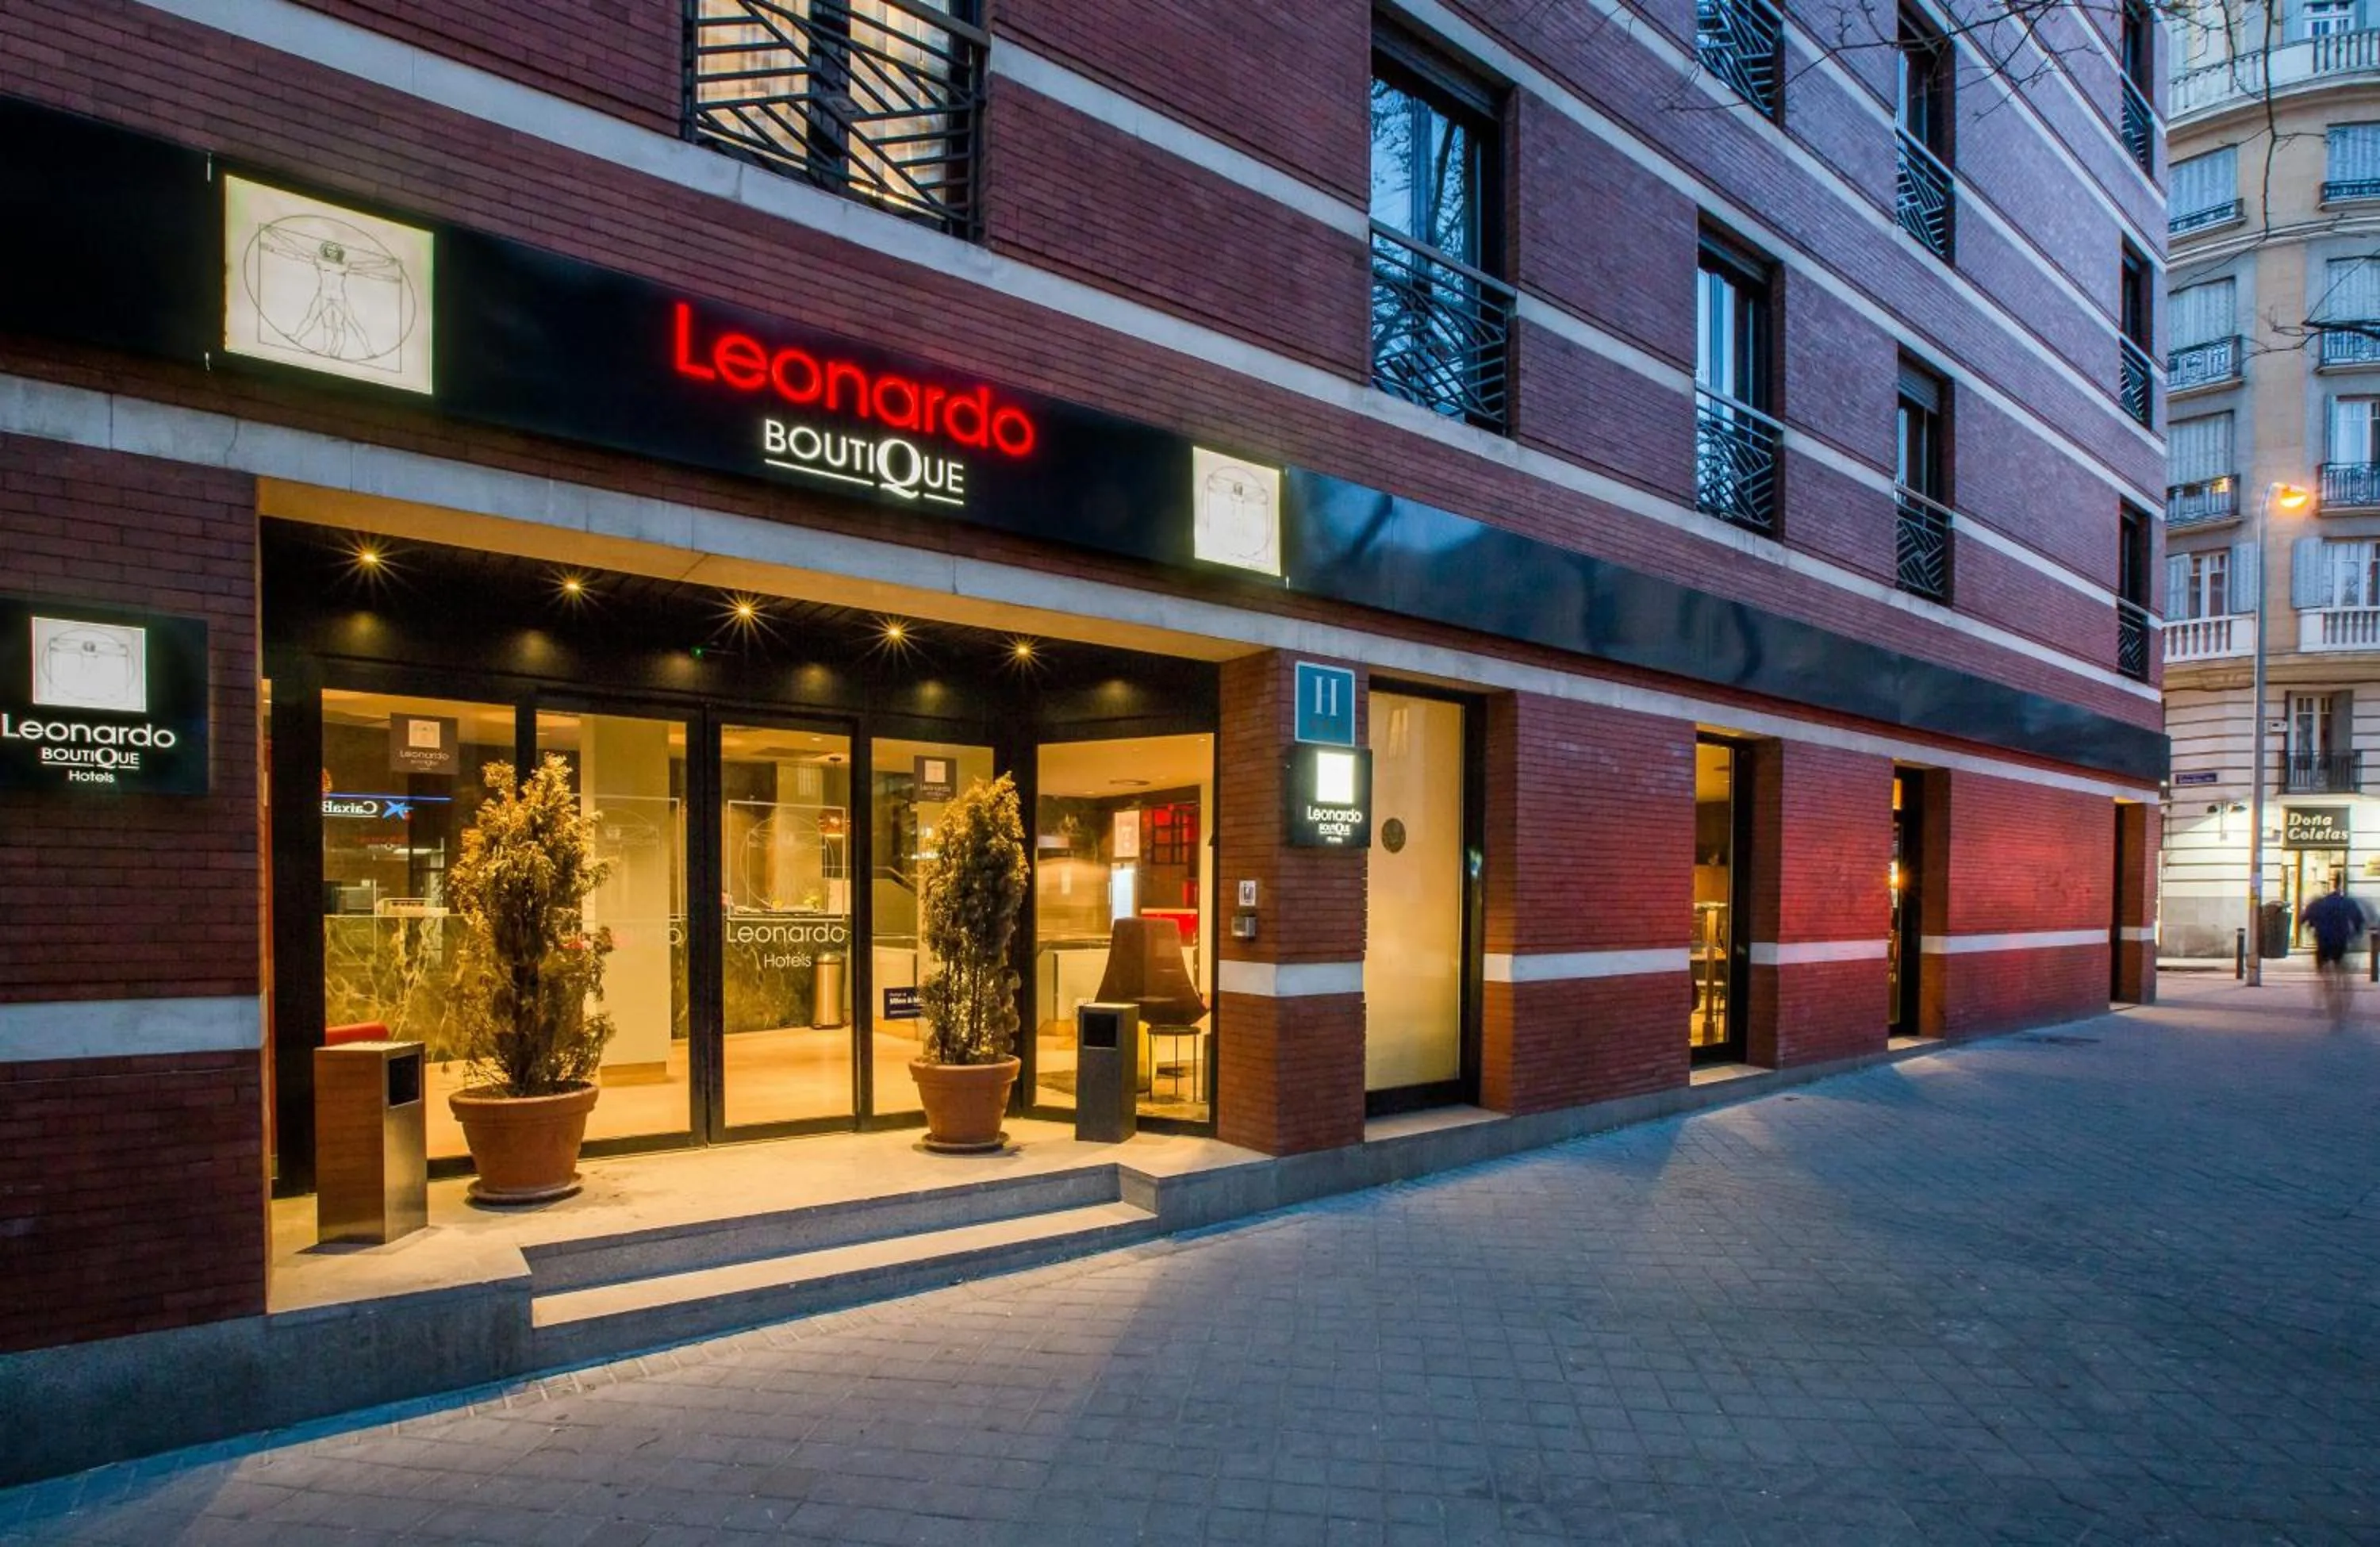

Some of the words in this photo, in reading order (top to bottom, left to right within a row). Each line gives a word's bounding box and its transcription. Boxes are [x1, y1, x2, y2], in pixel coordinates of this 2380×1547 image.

[674, 302, 1035, 457] Leonardo
[764, 418, 965, 499] BOUTIQUE
[2, 714, 175, 748] Leonardo
[40, 747, 140, 769] BOUTIQUE
[68, 770, 115, 783] Hotels
[1307, 805, 1362, 823] Leonardo
[726, 921, 846, 943] Leonardo
[763, 953, 812, 969] Hotels
